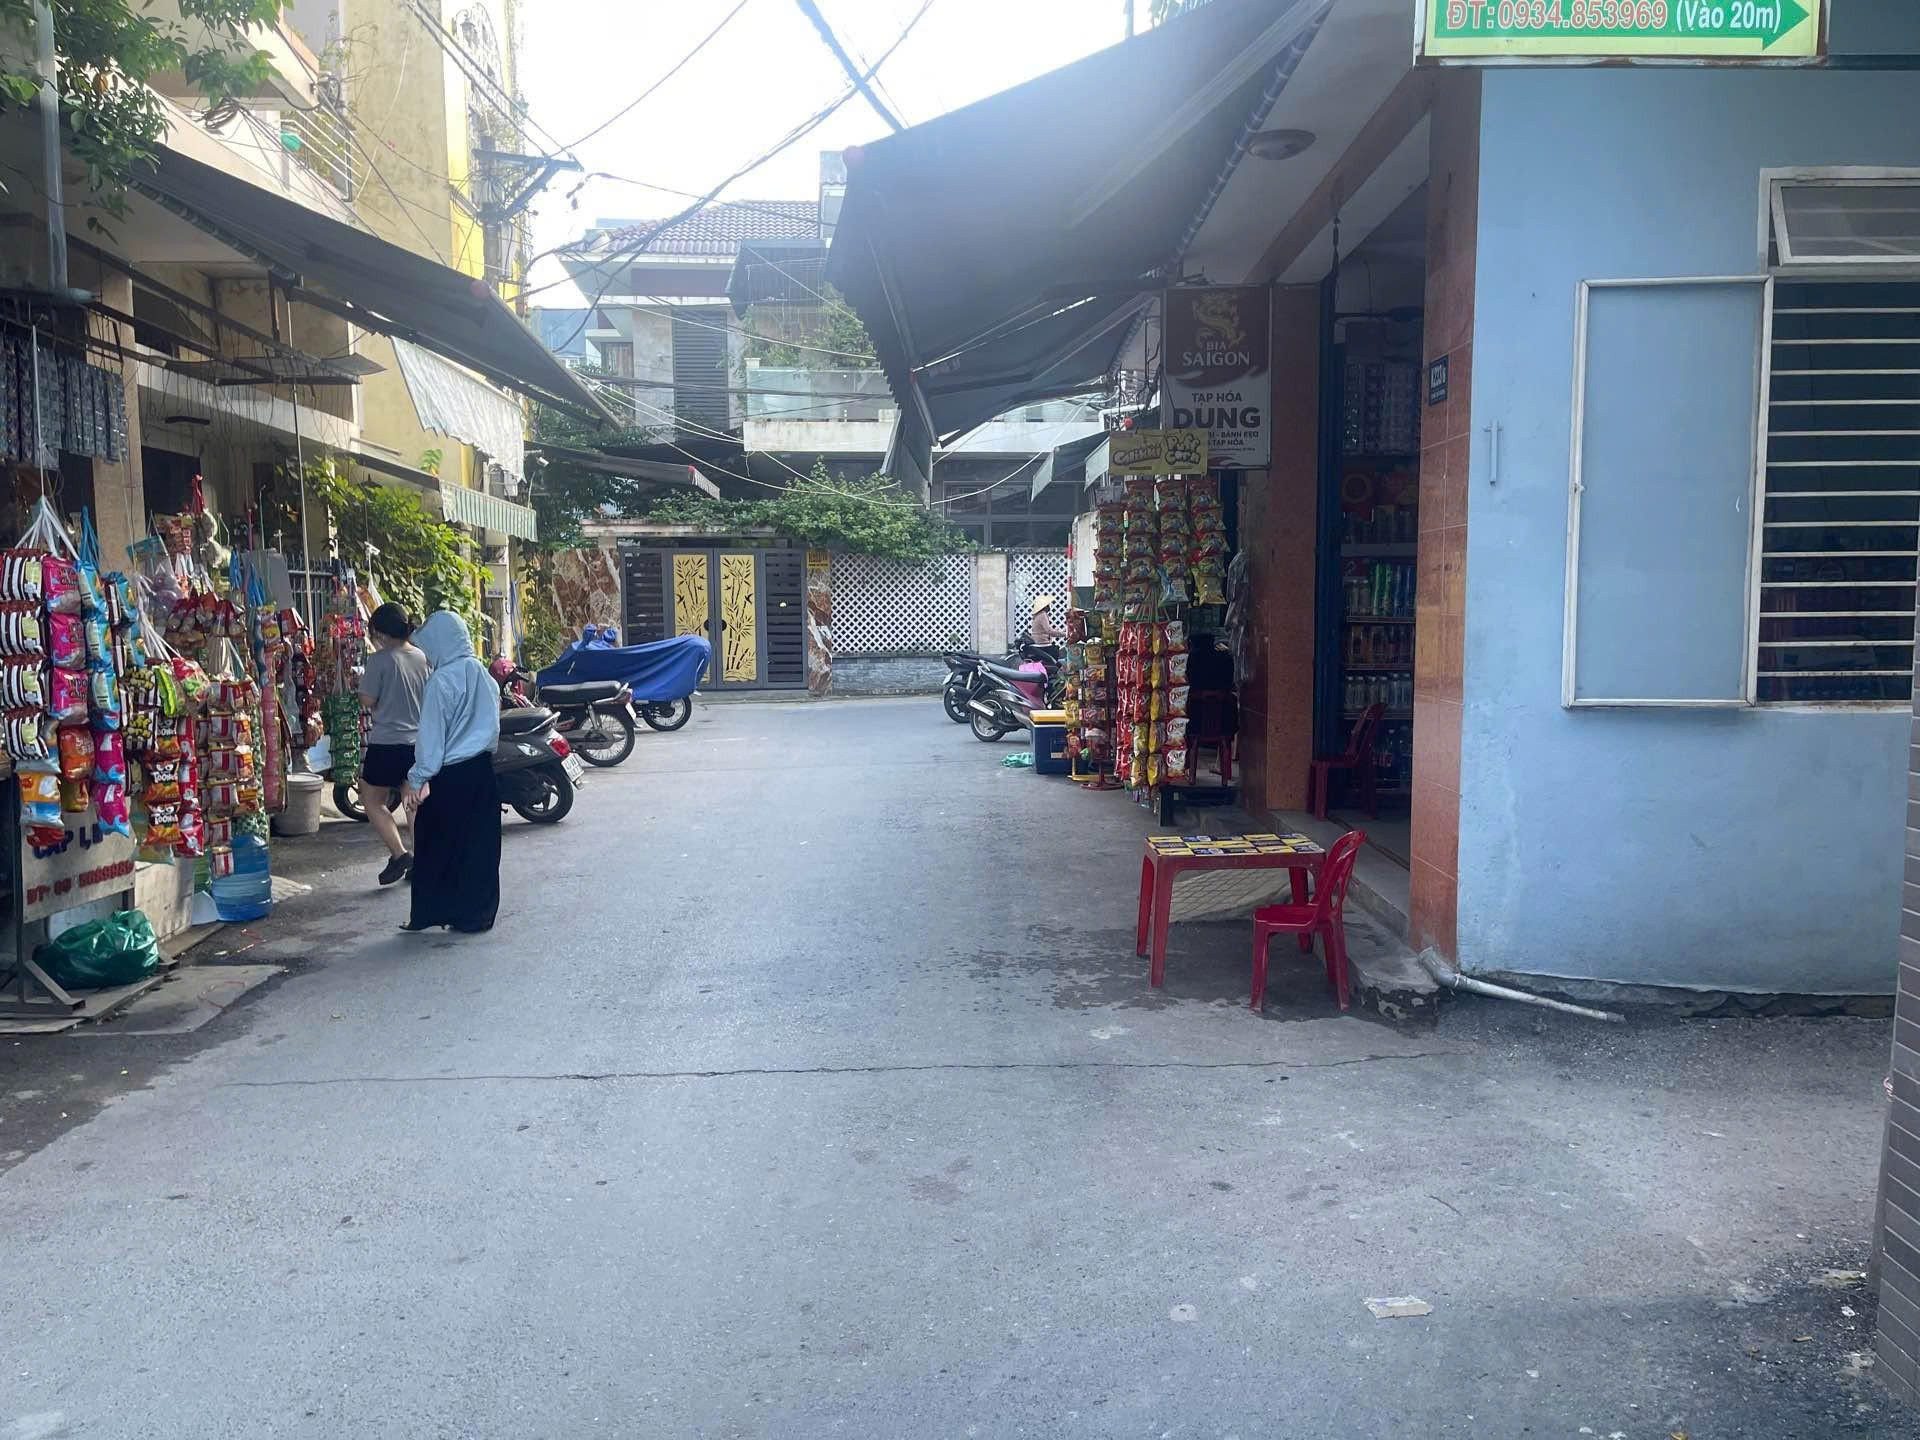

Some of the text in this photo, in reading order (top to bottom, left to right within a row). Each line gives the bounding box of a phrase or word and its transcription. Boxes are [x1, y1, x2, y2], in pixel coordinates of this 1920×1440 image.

[1676, 0, 1724, 31] (Vào
[1729, 0, 1782, 32] 20m)
[1206, 341, 1226, 351] BIA
[1183, 351, 1250, 366] SAIGON
[1191, 391, 1242, 406] TẠP HÓA
